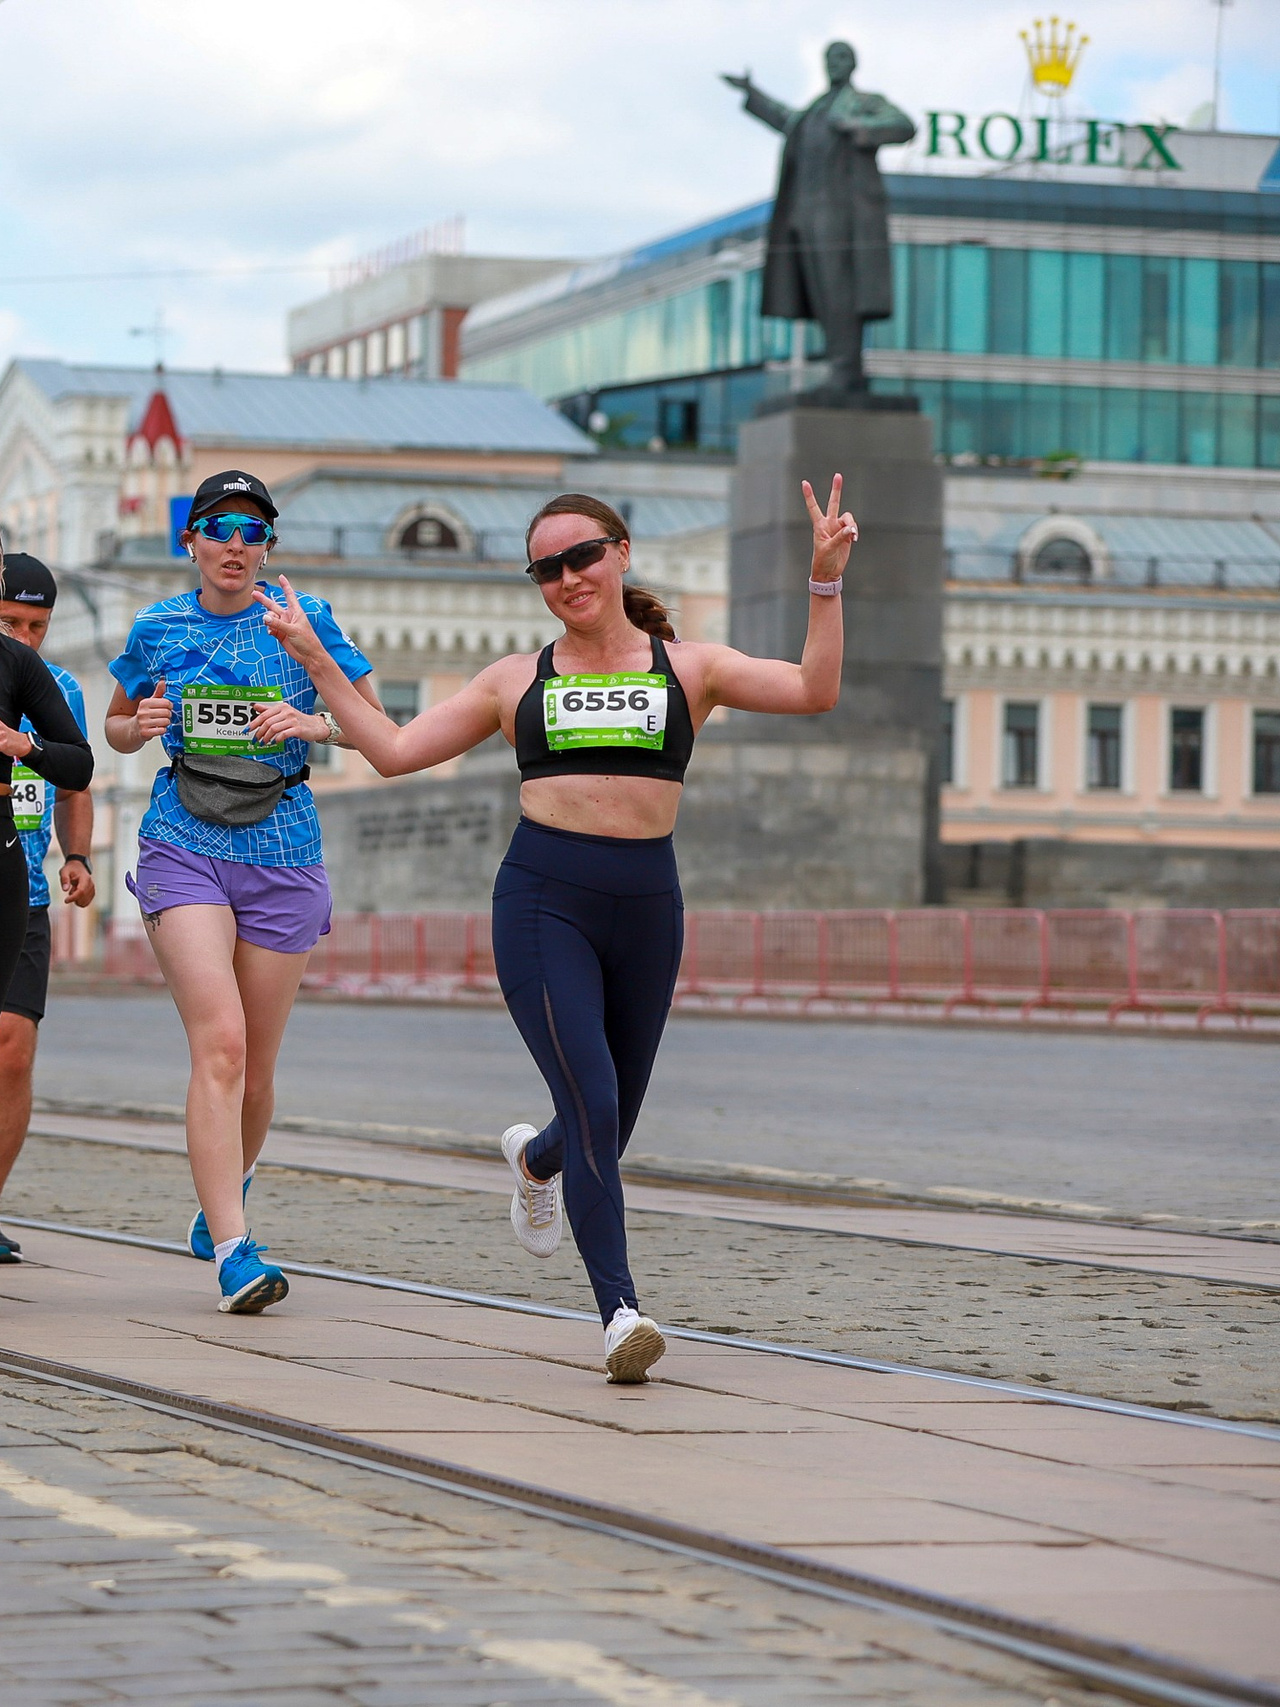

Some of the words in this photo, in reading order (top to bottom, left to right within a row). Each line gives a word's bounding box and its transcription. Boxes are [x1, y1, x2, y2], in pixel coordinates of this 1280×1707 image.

[925, 110, 1184, 171] ROLEX
[223, 482, 248, 491] PUMA
[562, 689, 650, 712] 6556
[647, 715, 657, 731] E
[35, 800, 43, 813] D
